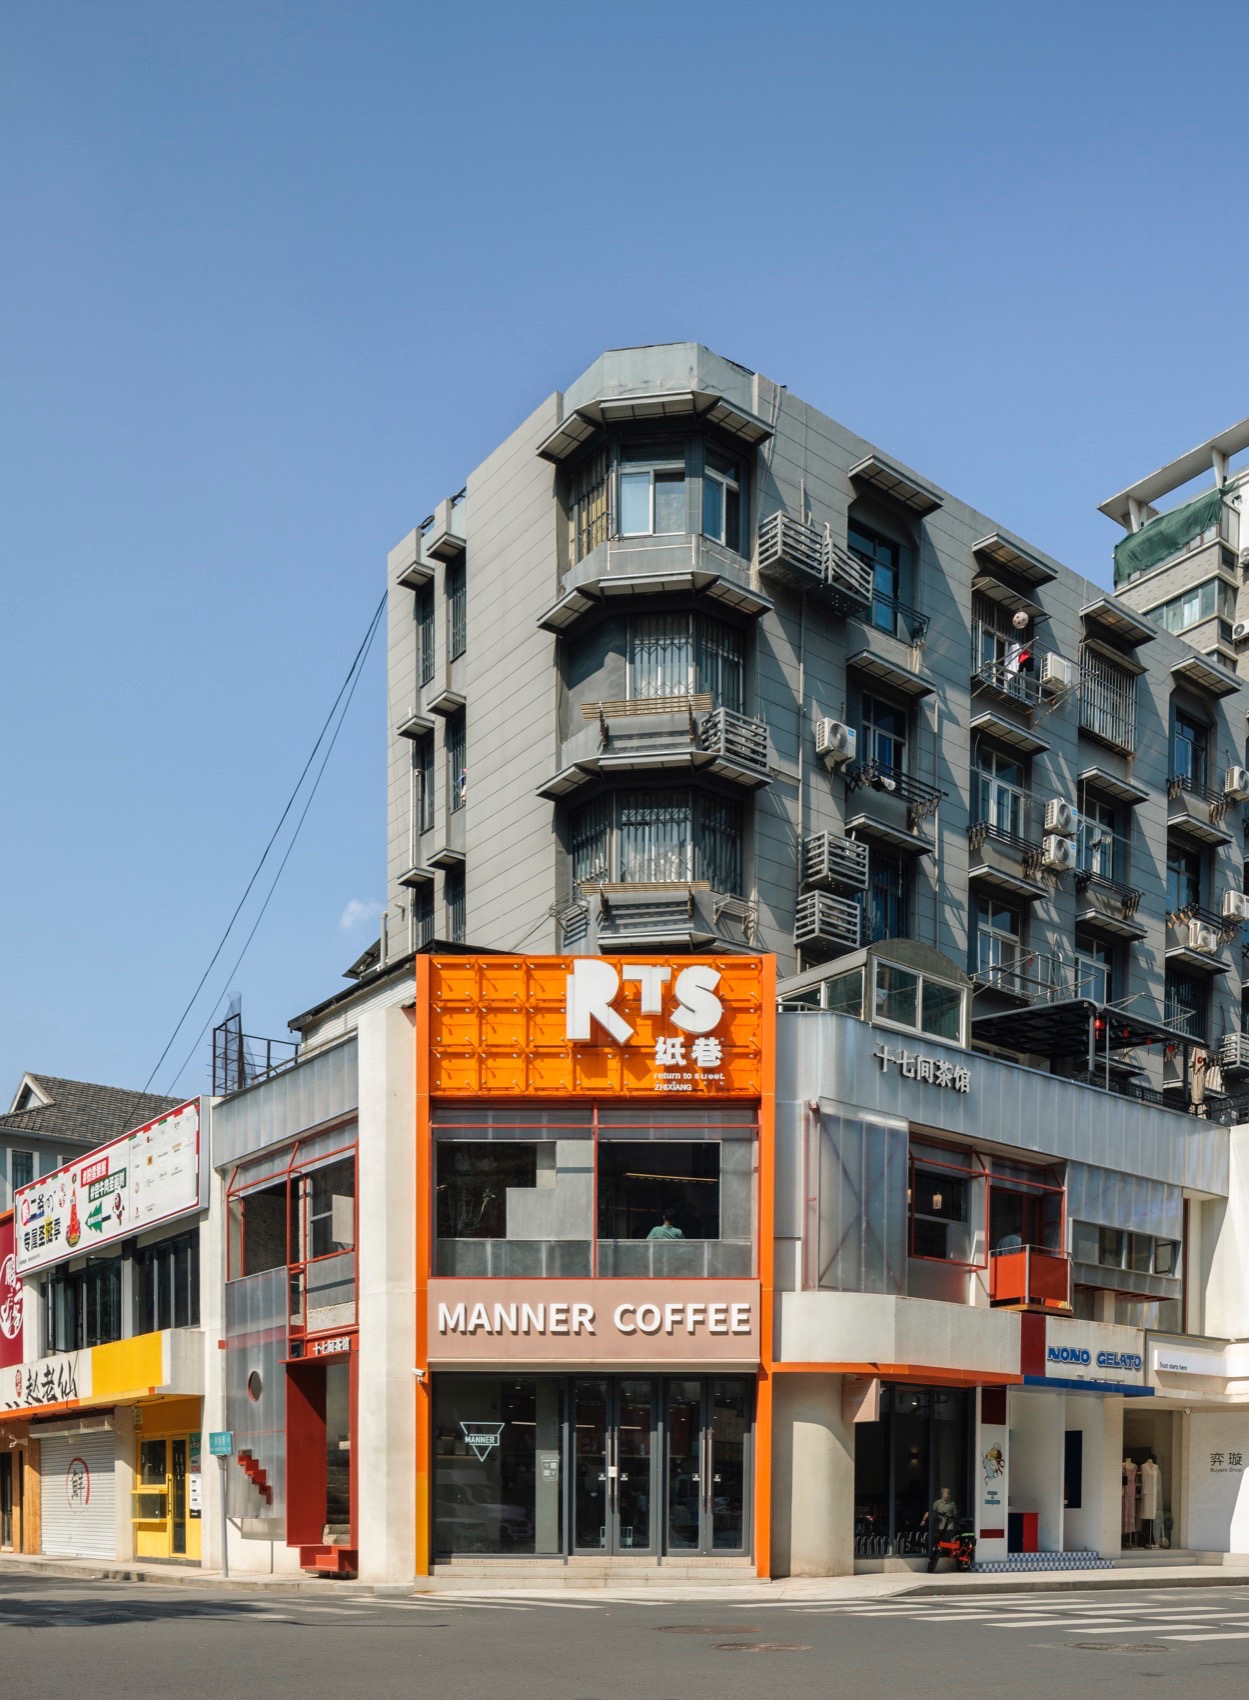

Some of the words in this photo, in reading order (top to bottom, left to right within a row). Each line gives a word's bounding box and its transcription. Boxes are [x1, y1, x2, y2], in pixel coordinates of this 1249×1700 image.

[566, 959, 722, 1046] RTS
[654, 1036, 722, 1068] 纸巷
[873, 1044, 971, 1093] 十七间茶馆
[438, 1302, 596, 1334] MANNER
[613, 1302, 752, 1334] COFFEE
[1047, 1345, 1091, 1365] NONO
[1096, 1350, 1143, 1370] GELATO
[26, 1360, 79, 1403] 赵老仙
[464, 1436, 495, 1444] MANNER
[1209, 1451, 1242, 1466] 弈璇
